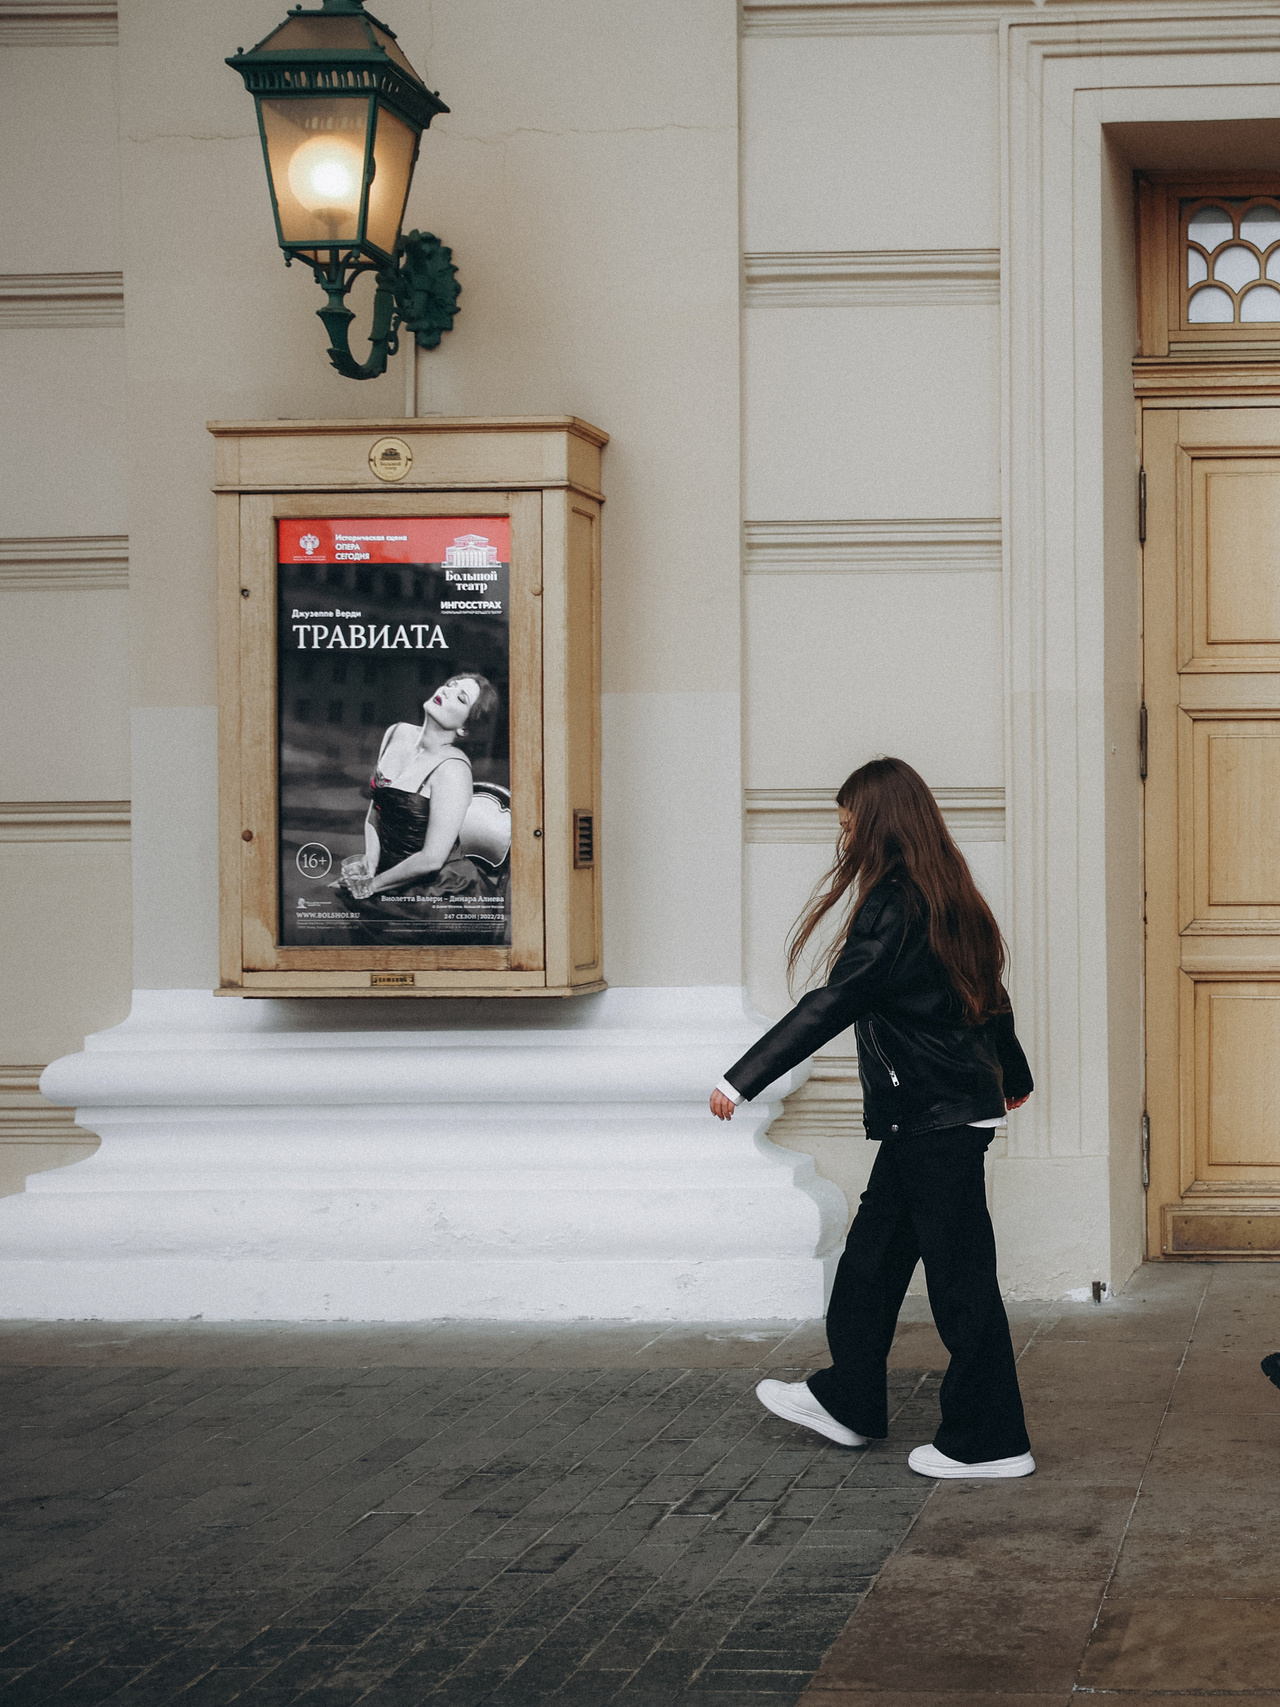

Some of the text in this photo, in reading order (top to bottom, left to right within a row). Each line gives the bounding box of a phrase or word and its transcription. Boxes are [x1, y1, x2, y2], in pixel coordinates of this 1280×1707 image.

[335, 533, 408, 543] Историческая сцена
[335, 543, 361, 551] ОПЕРА
[335, 552, 370, 561] СЕГОДНЯ
[445, 570, 498, 582] Большой
[455, 582, 488, 594] театр
[440, 600, 502, 610] ИНГОССТРАХ
[291, 609, 362, 619] Джузеппе Верди
[292, 624, 449, 650] ТРАВИАТА
[302, 853, 328, 869] 16+
[381, 895, 415, 903] Виолетта
[416, 895, 443, 904] Валери
[449, 895, 477, 904] Динара
[477, 895, 505, 903] Алиева
[480, 913, 505, 921] 2022/23
